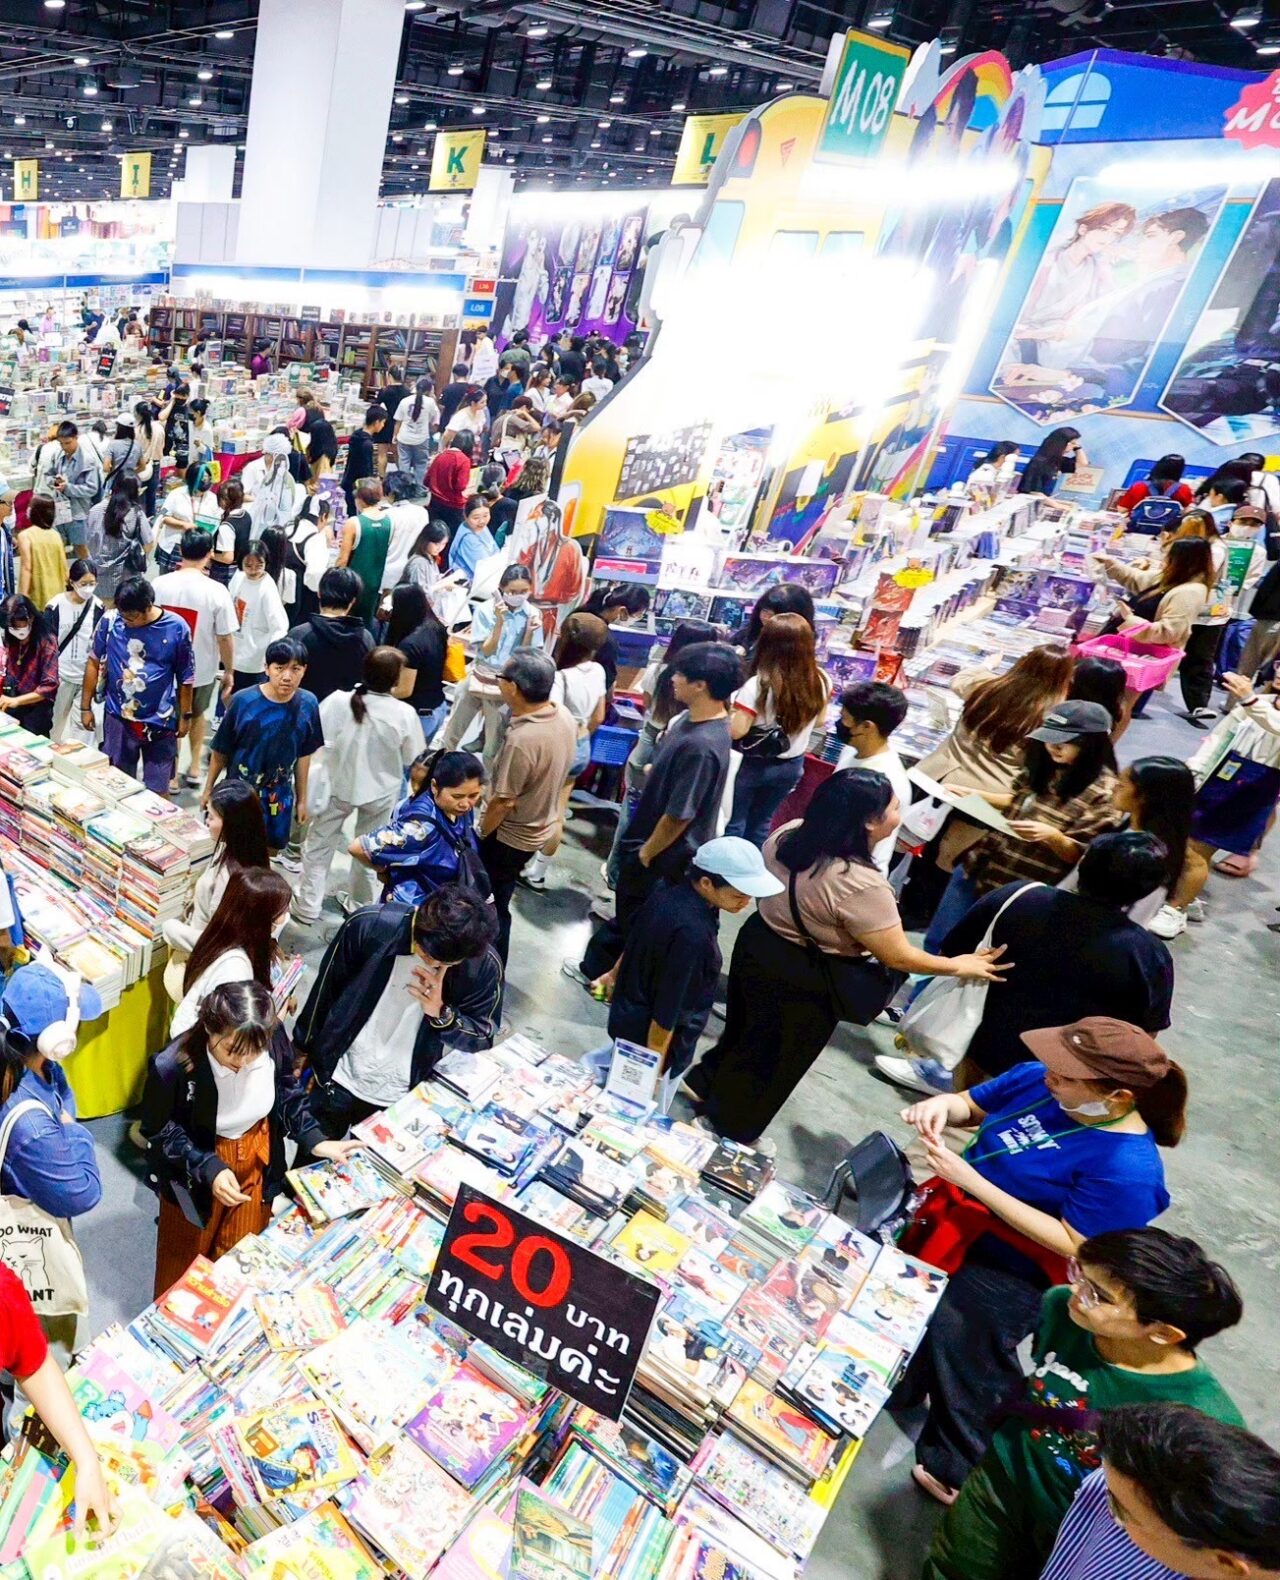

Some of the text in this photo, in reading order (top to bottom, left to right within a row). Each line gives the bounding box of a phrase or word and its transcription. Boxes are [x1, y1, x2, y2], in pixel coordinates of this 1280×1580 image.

[447, 146, 468, 174] K
[700, 133, 717, 164] L
[21, 171, 31, 188] H
[132, 165, 139, 185] I
[17, 1224, 53, 1238] WHAT
[450, 1202, 572, 1309] 20
[565, 1303, 631, 1355] บาท
[437, 1269, 620, 1395] ทุกเล่มค่ะ
